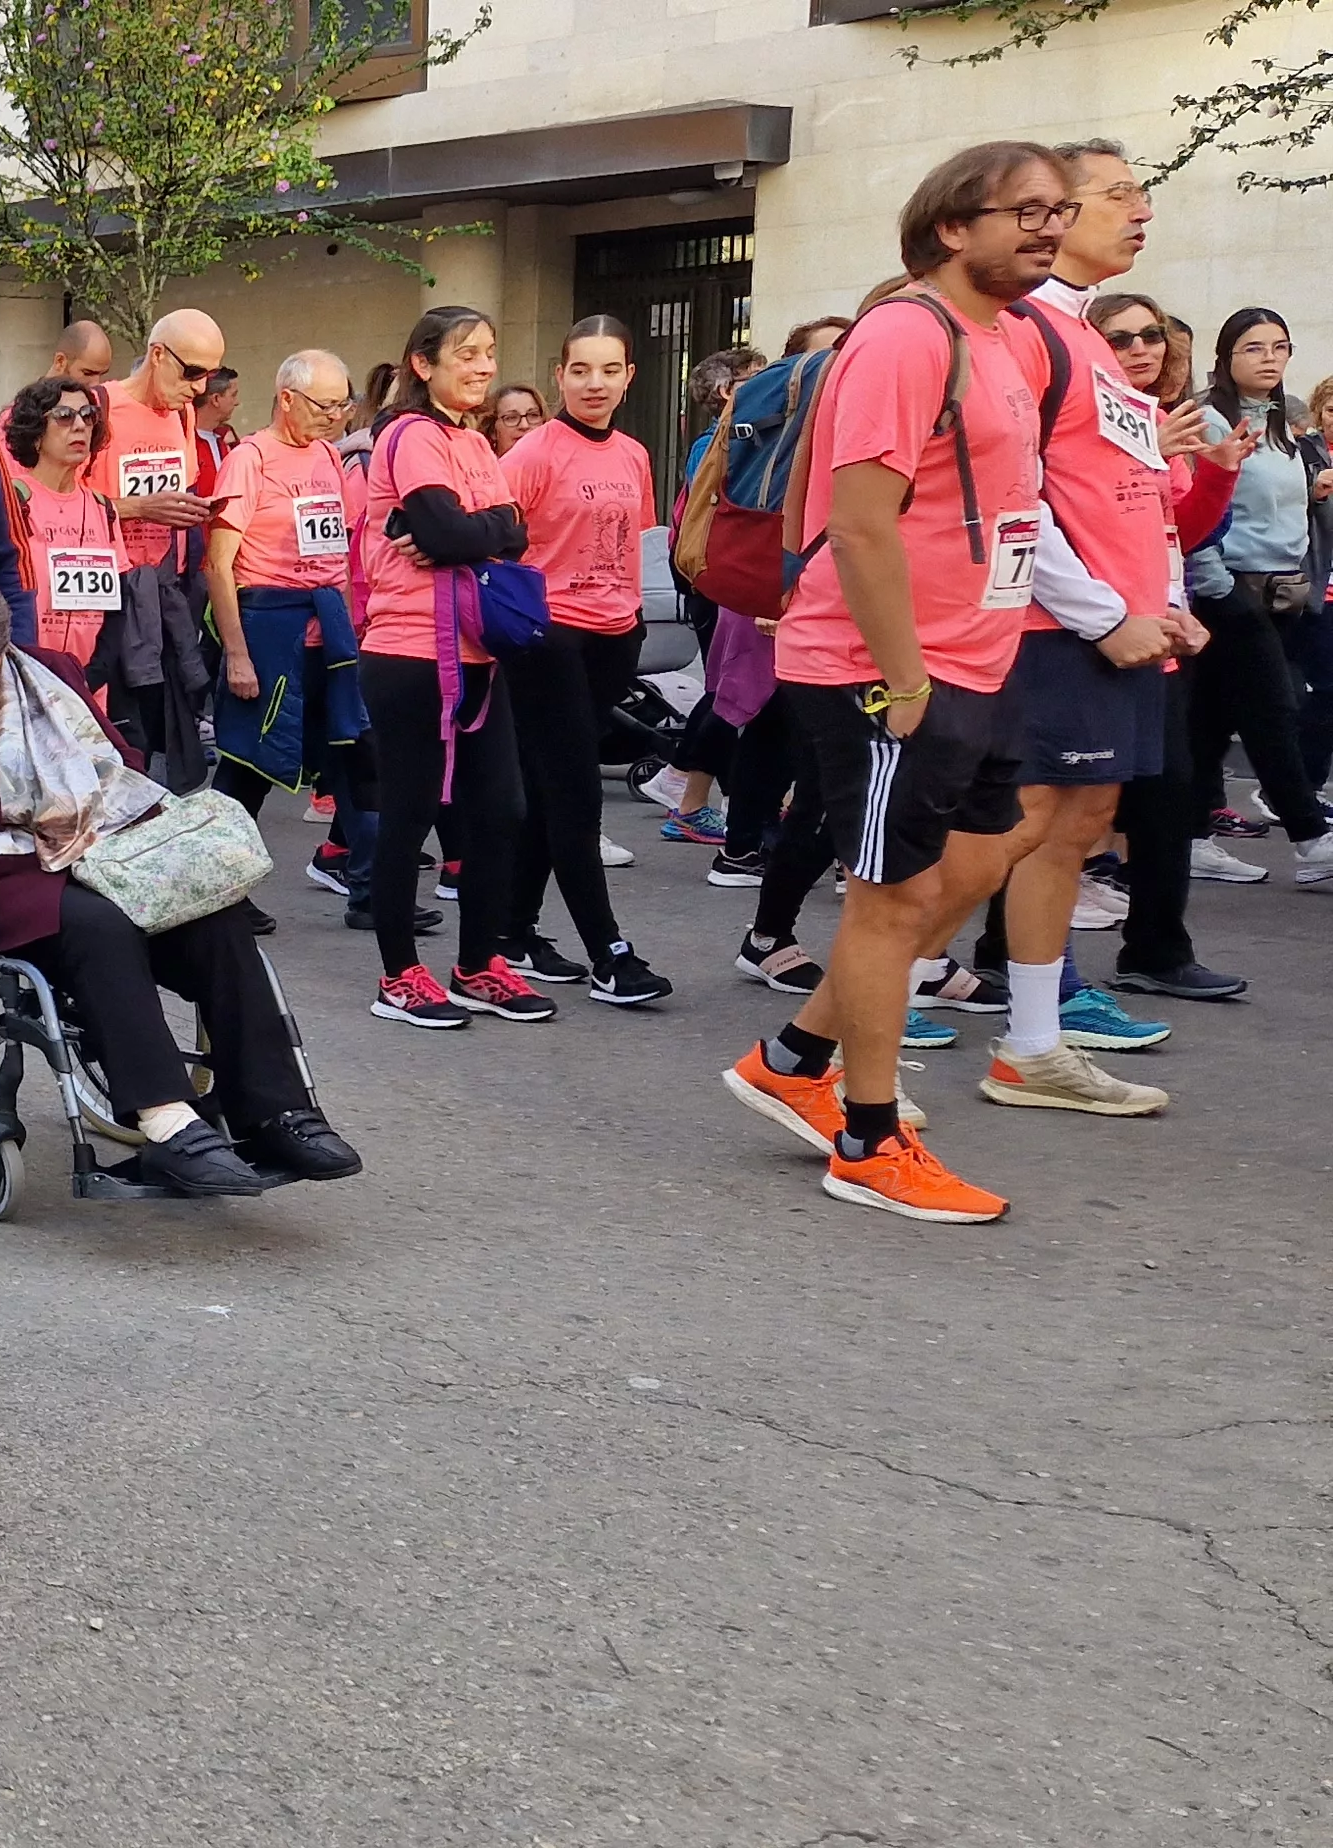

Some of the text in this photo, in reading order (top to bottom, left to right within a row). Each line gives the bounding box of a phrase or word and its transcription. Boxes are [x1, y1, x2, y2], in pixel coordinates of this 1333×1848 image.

[1101, 391, 1152, 450] 3291
[127, 473, 180, 497] 2129
[57, 570, 114, 594] 2130
